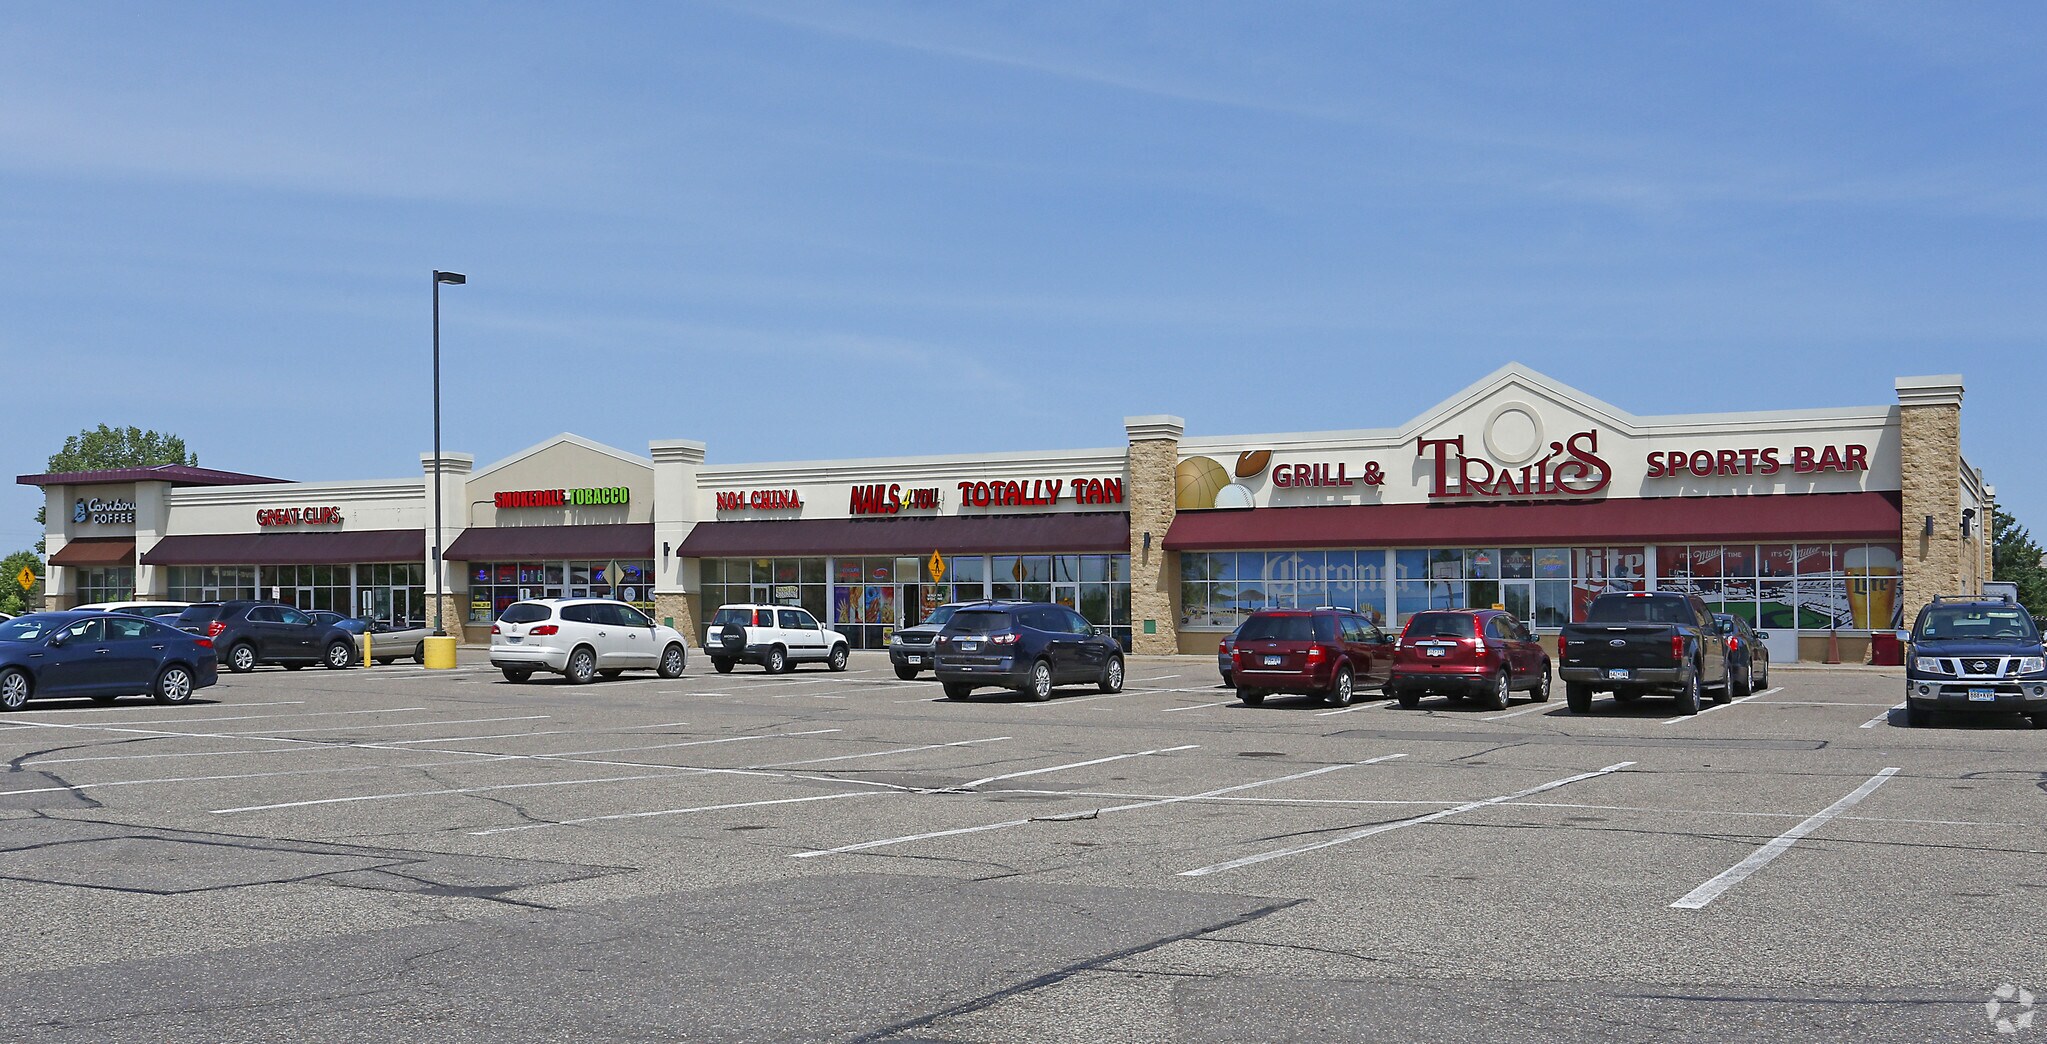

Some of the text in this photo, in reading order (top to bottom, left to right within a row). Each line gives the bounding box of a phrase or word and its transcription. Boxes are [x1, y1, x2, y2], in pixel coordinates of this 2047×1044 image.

[1272, 461, 1385, 488] GRILL &
[1647, 444, 1869, 478] SPORTS BAR
[88, 497, 137, 512] Caribou
[494, 486, 630, 508] SMOKEDALE TOBACCO
[716, 489, 801, 511] NO1 CHINA
[850, 484, 939, 515] NAILS 4 YOU
[957, 477, 1123, 507] TOTALLY TAN
[93, 512, 134, 524] COFFEE
[256, 506, 341, 526] GREAT CLIPS
[1261, 554, 1410, 598] Corona
[1572, 548, 1645, 592] Lite
